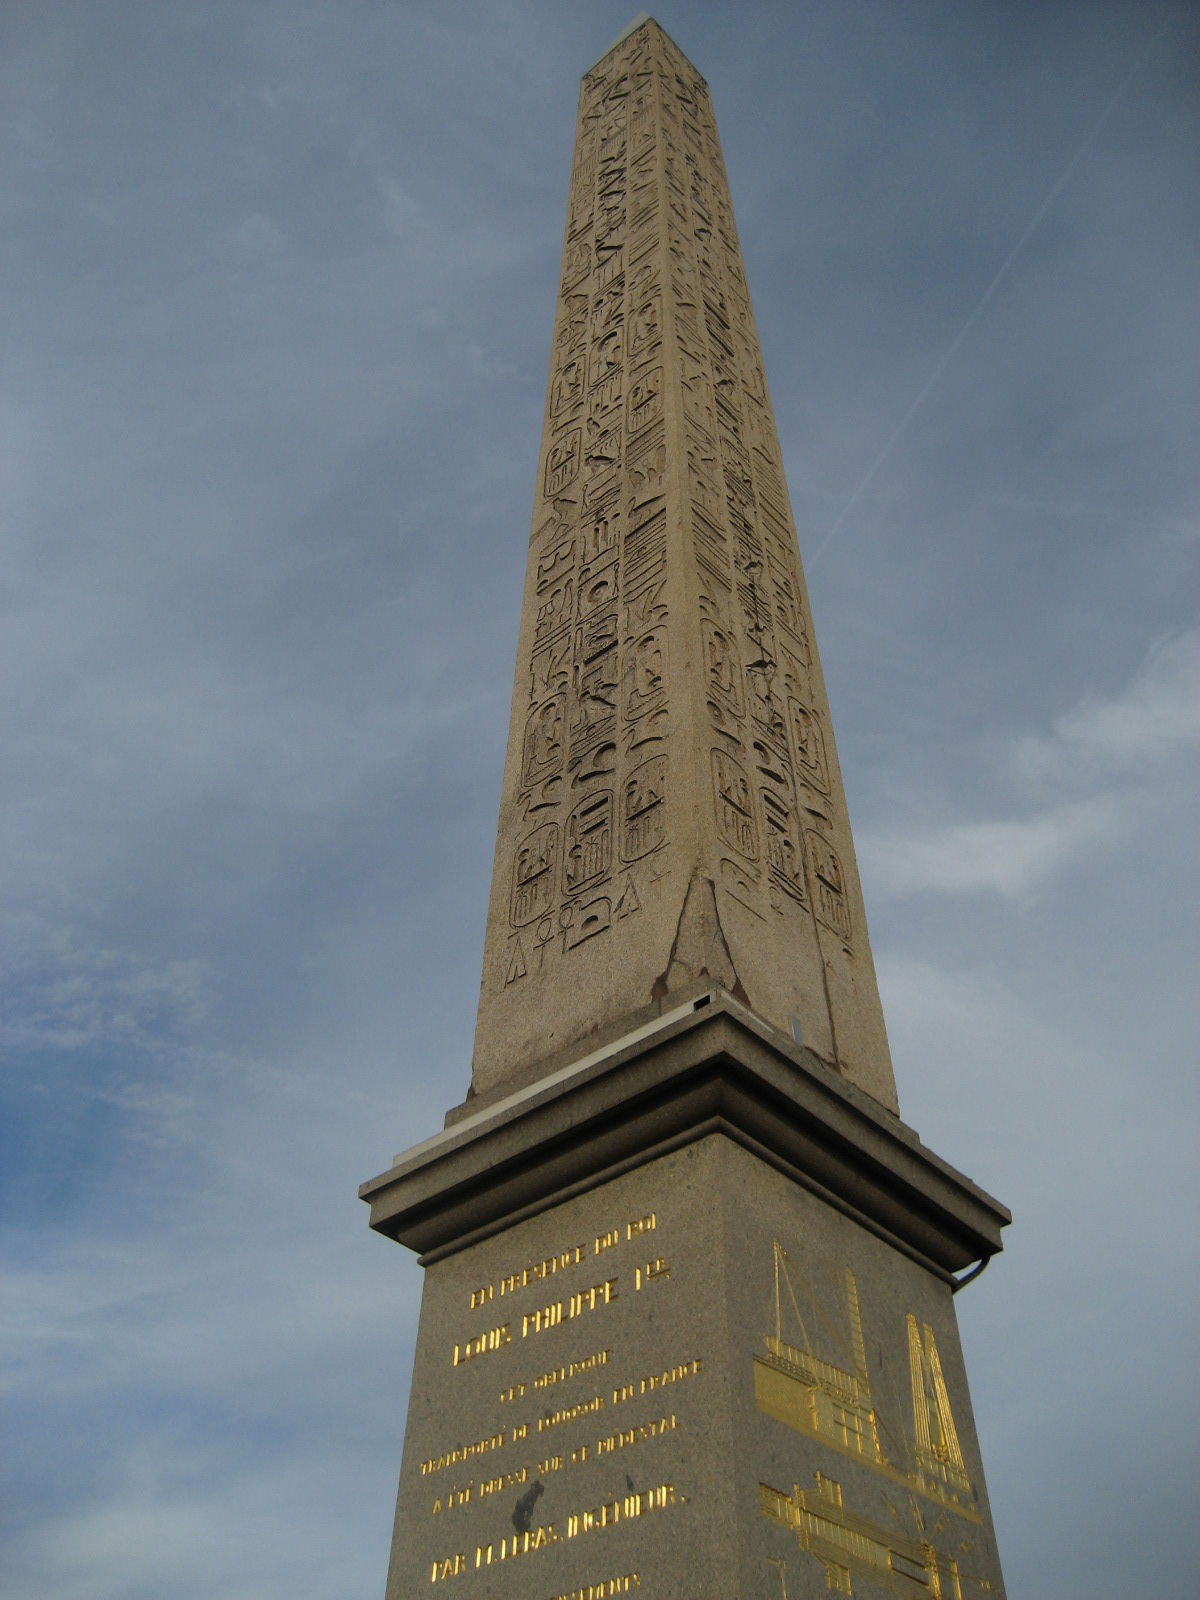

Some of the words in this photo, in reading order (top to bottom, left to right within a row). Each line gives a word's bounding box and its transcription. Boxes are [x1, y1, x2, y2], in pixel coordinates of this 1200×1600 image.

[470, 1284, 494, 1309] EN
[595, 1229, 619, 1256] DU
[627, 1212, 656, 1240] ROI
[453, 1323, 511, 1366] LOUIS
[522, 1277, 618, 1338] PHILIPPE
[500, 1383, 527, 1402] CET
[513, 1424, 530, 1442] DE
[613, 1384, 634, 1404] EN
[641, 1359, 702, 1394] FRANCE
[538, 1456, 563, 1476] SUR
[572, 1445, 589, 1463] CE
[431, 1553, 466, 1583] PAR
